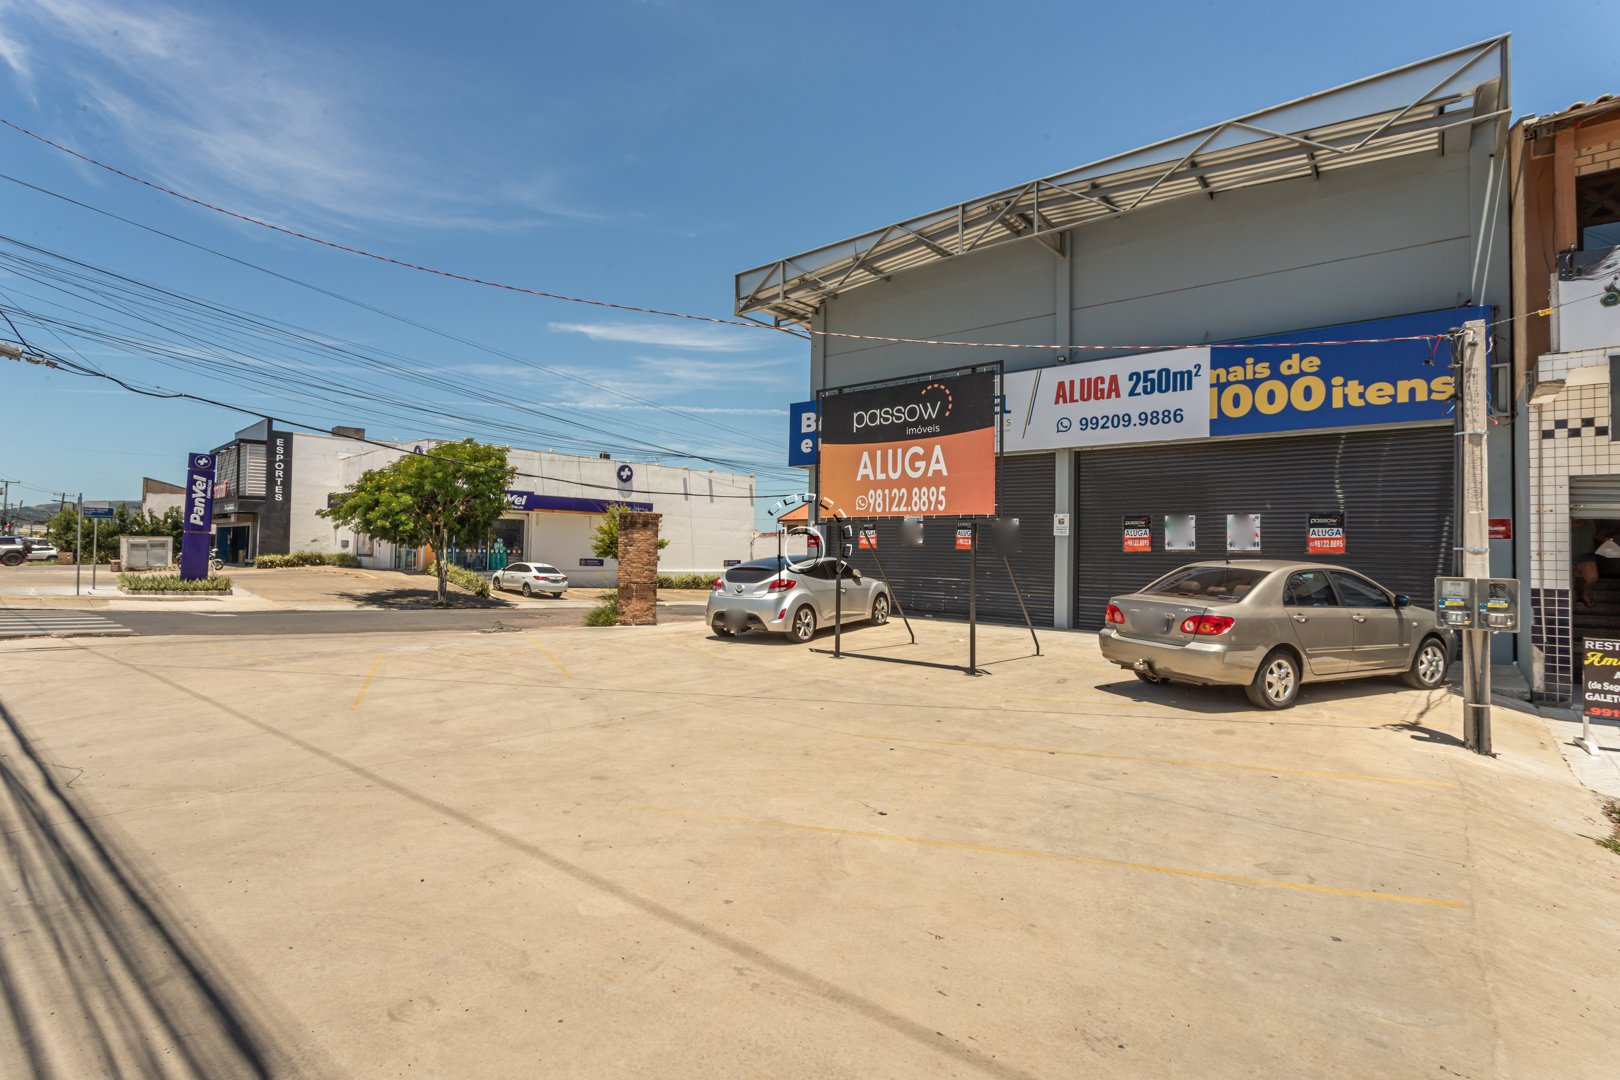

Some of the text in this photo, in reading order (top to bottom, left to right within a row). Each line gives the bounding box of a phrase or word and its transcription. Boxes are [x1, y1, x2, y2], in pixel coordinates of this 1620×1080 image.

[1279, 353, 1321, 376] de
[1054, 374, 1121, 405] ALUGA
[1331, 374, 1456, 409] itens
[852, 401, 941, 433] passow
[906, 424, 940, 435] imóveis
[1079, 408, 1184, 431] 99209.9886
[274, 438, 284, 502] ESPORTES
[856, 444, 948, 481] ALUGA
[189, 474, 207, 526] PanVel
[867, 486, 946, 513] 98122.8895
[1125, 529, 1148, 537] ALUGA
[1310, 528, 1342, 537] ALUGA
[1588, 681, 1602, 690] (de
